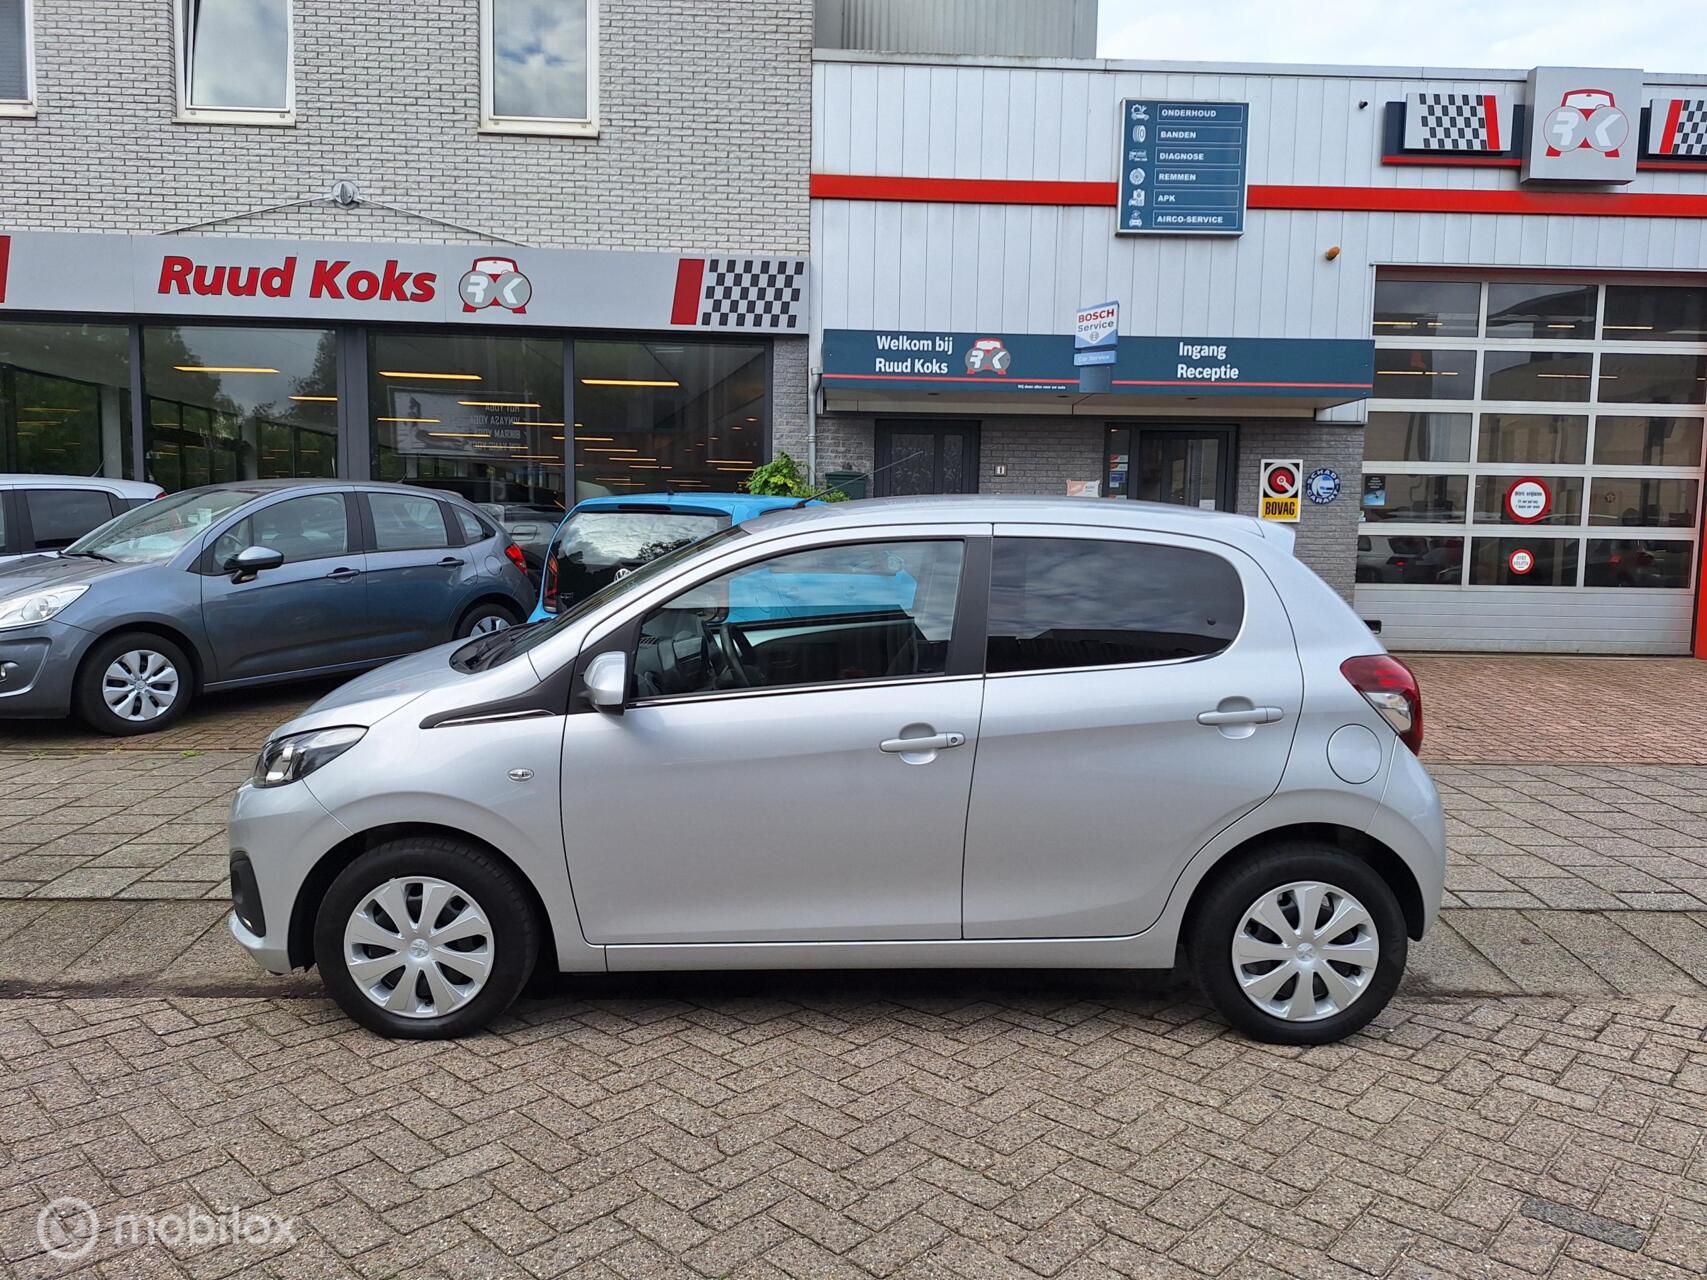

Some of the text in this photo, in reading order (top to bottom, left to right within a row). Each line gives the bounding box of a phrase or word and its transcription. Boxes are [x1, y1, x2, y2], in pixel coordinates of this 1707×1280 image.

[1161, 108, 1217, 118] ONDERHOUD
[1160, 130, 1197, 139] BANDEN
[1159, 152, 1205, 161] DIAGNOSE
[1158, 173, 1197, 181] REMMEN
[1157, 194, 1176, 202] APK
[1156, 215, 1224, 223] AIRCO-SERVICE
[157, 255, 438, 303] Ruud Koks
[1078, 308, 1115, 323] BOSCH
[1077, 320, 1114, 333] Service
[876, 335, 953, 355] Welkom bij
[1178, 341, 1227, 360] Ingang
[875, 357, 948, 374] Ruud Koks
[1177, 363, 1239, 382] Receptie
[1307, 469, 1340, 484] SCHADE
[1307, 489, 1338, 504] GARANT
[1265, 501, 1296, 516] BOVAG
